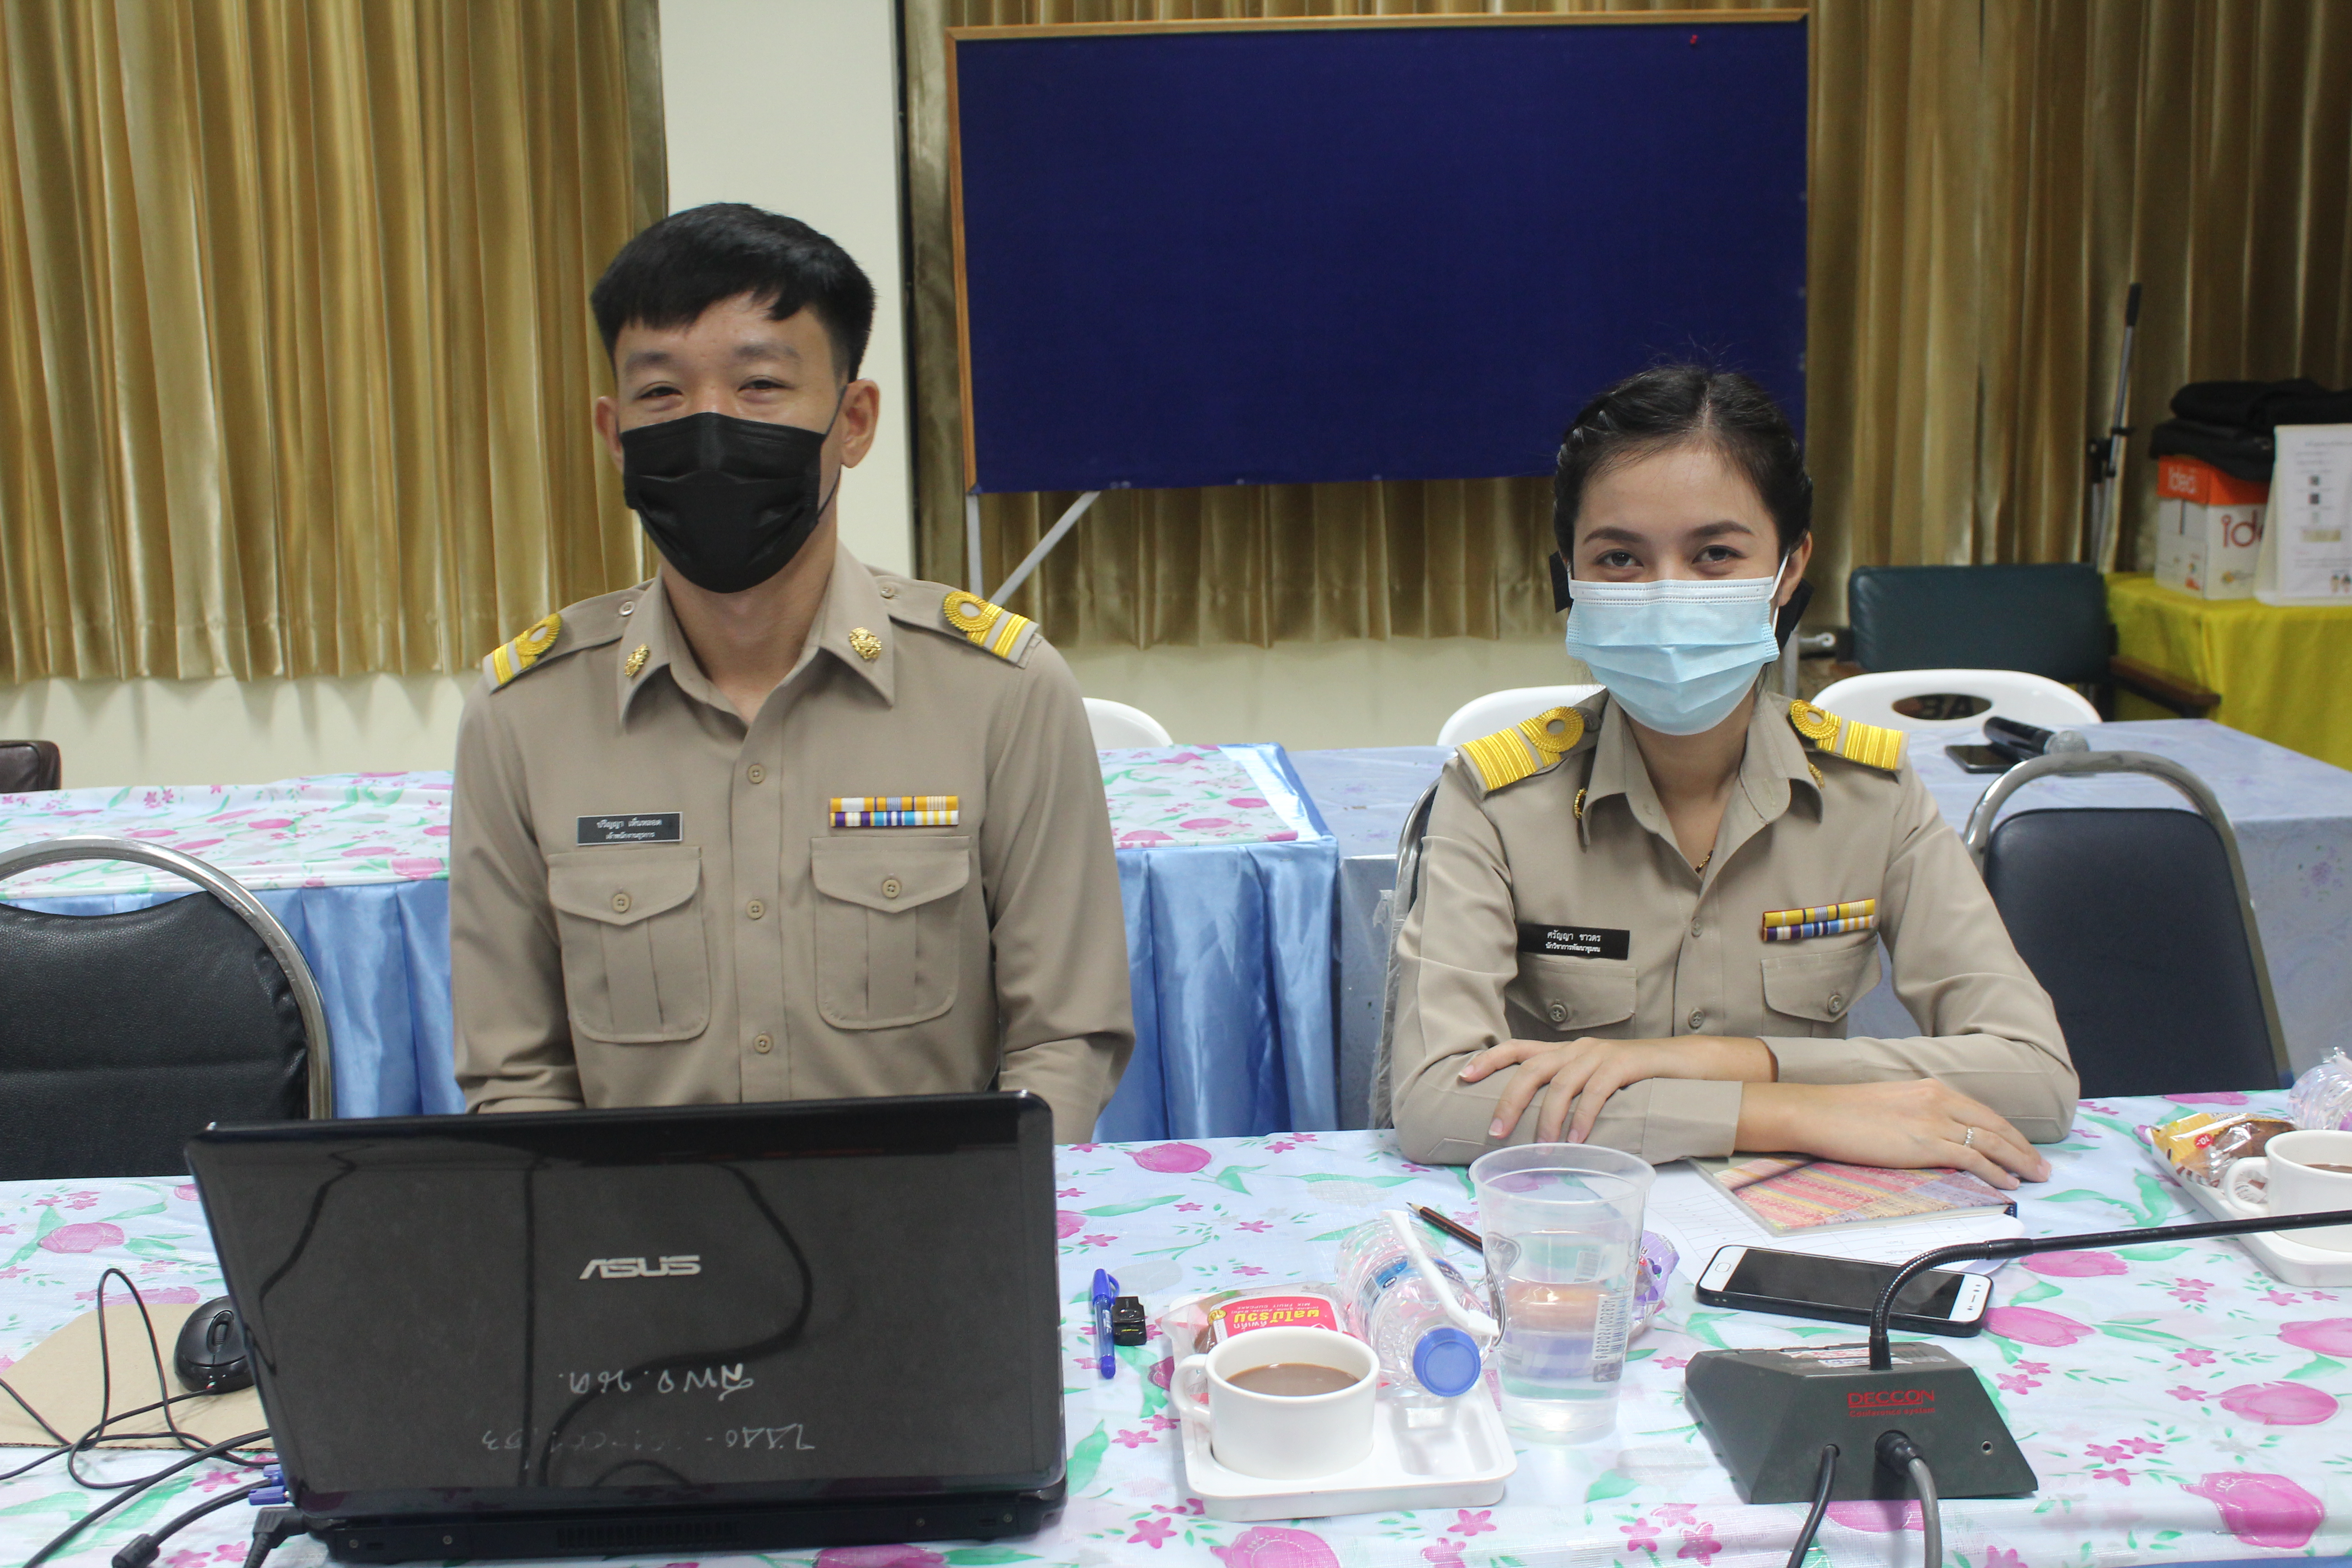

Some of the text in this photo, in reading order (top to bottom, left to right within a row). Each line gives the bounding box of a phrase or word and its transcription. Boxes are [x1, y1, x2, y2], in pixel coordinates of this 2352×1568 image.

[2221, 510, 2264, 547] id
[1547, 930, 1573, 941] ศรัญญา
[579, 1254, 701, 1280] ASUS
[1847, 1389, 1935, 1405] DECCON
